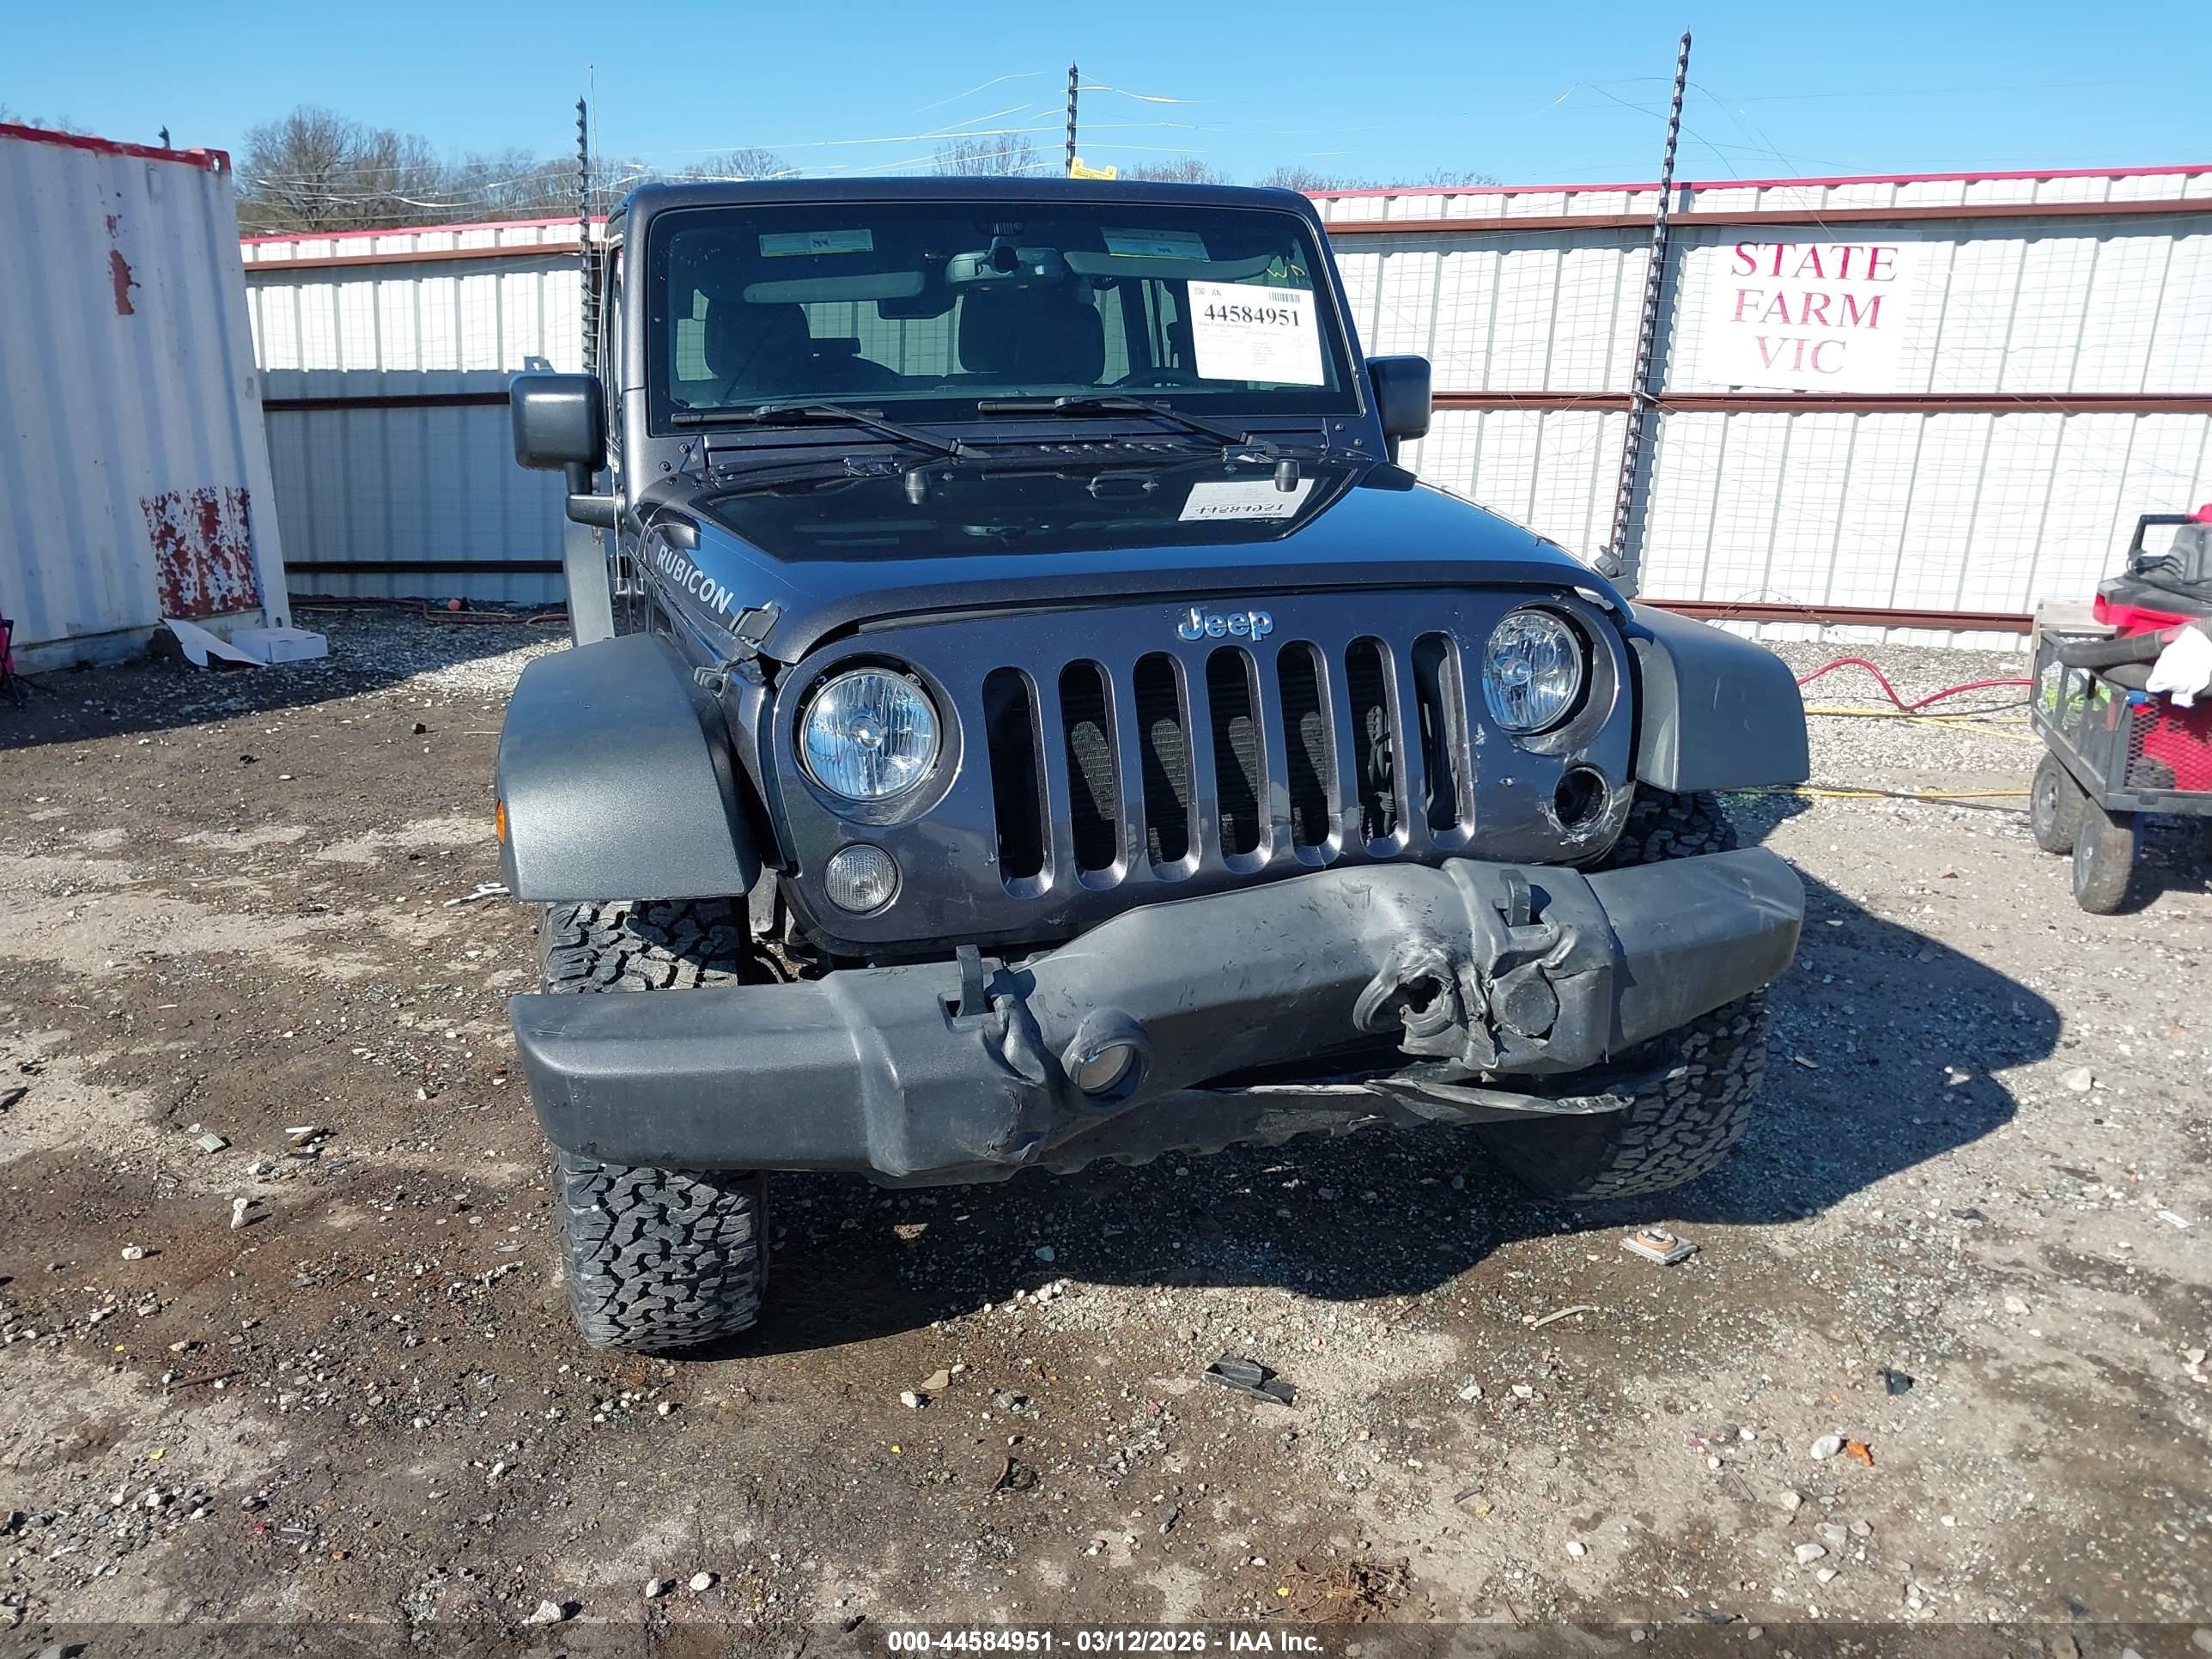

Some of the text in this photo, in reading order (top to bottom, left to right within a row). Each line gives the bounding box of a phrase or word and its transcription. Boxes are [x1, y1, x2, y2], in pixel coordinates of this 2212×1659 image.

[1731, 240, 1899, 282] STATE
[1204, 304, 1300, 326] 44584951
[1729, 289, 1886, 329] FARM
[1755, 336, 1846, 374] VIC
[656, 544, 734, 615] RUBICON
[1177, 606, 1273, 641] Jeep
